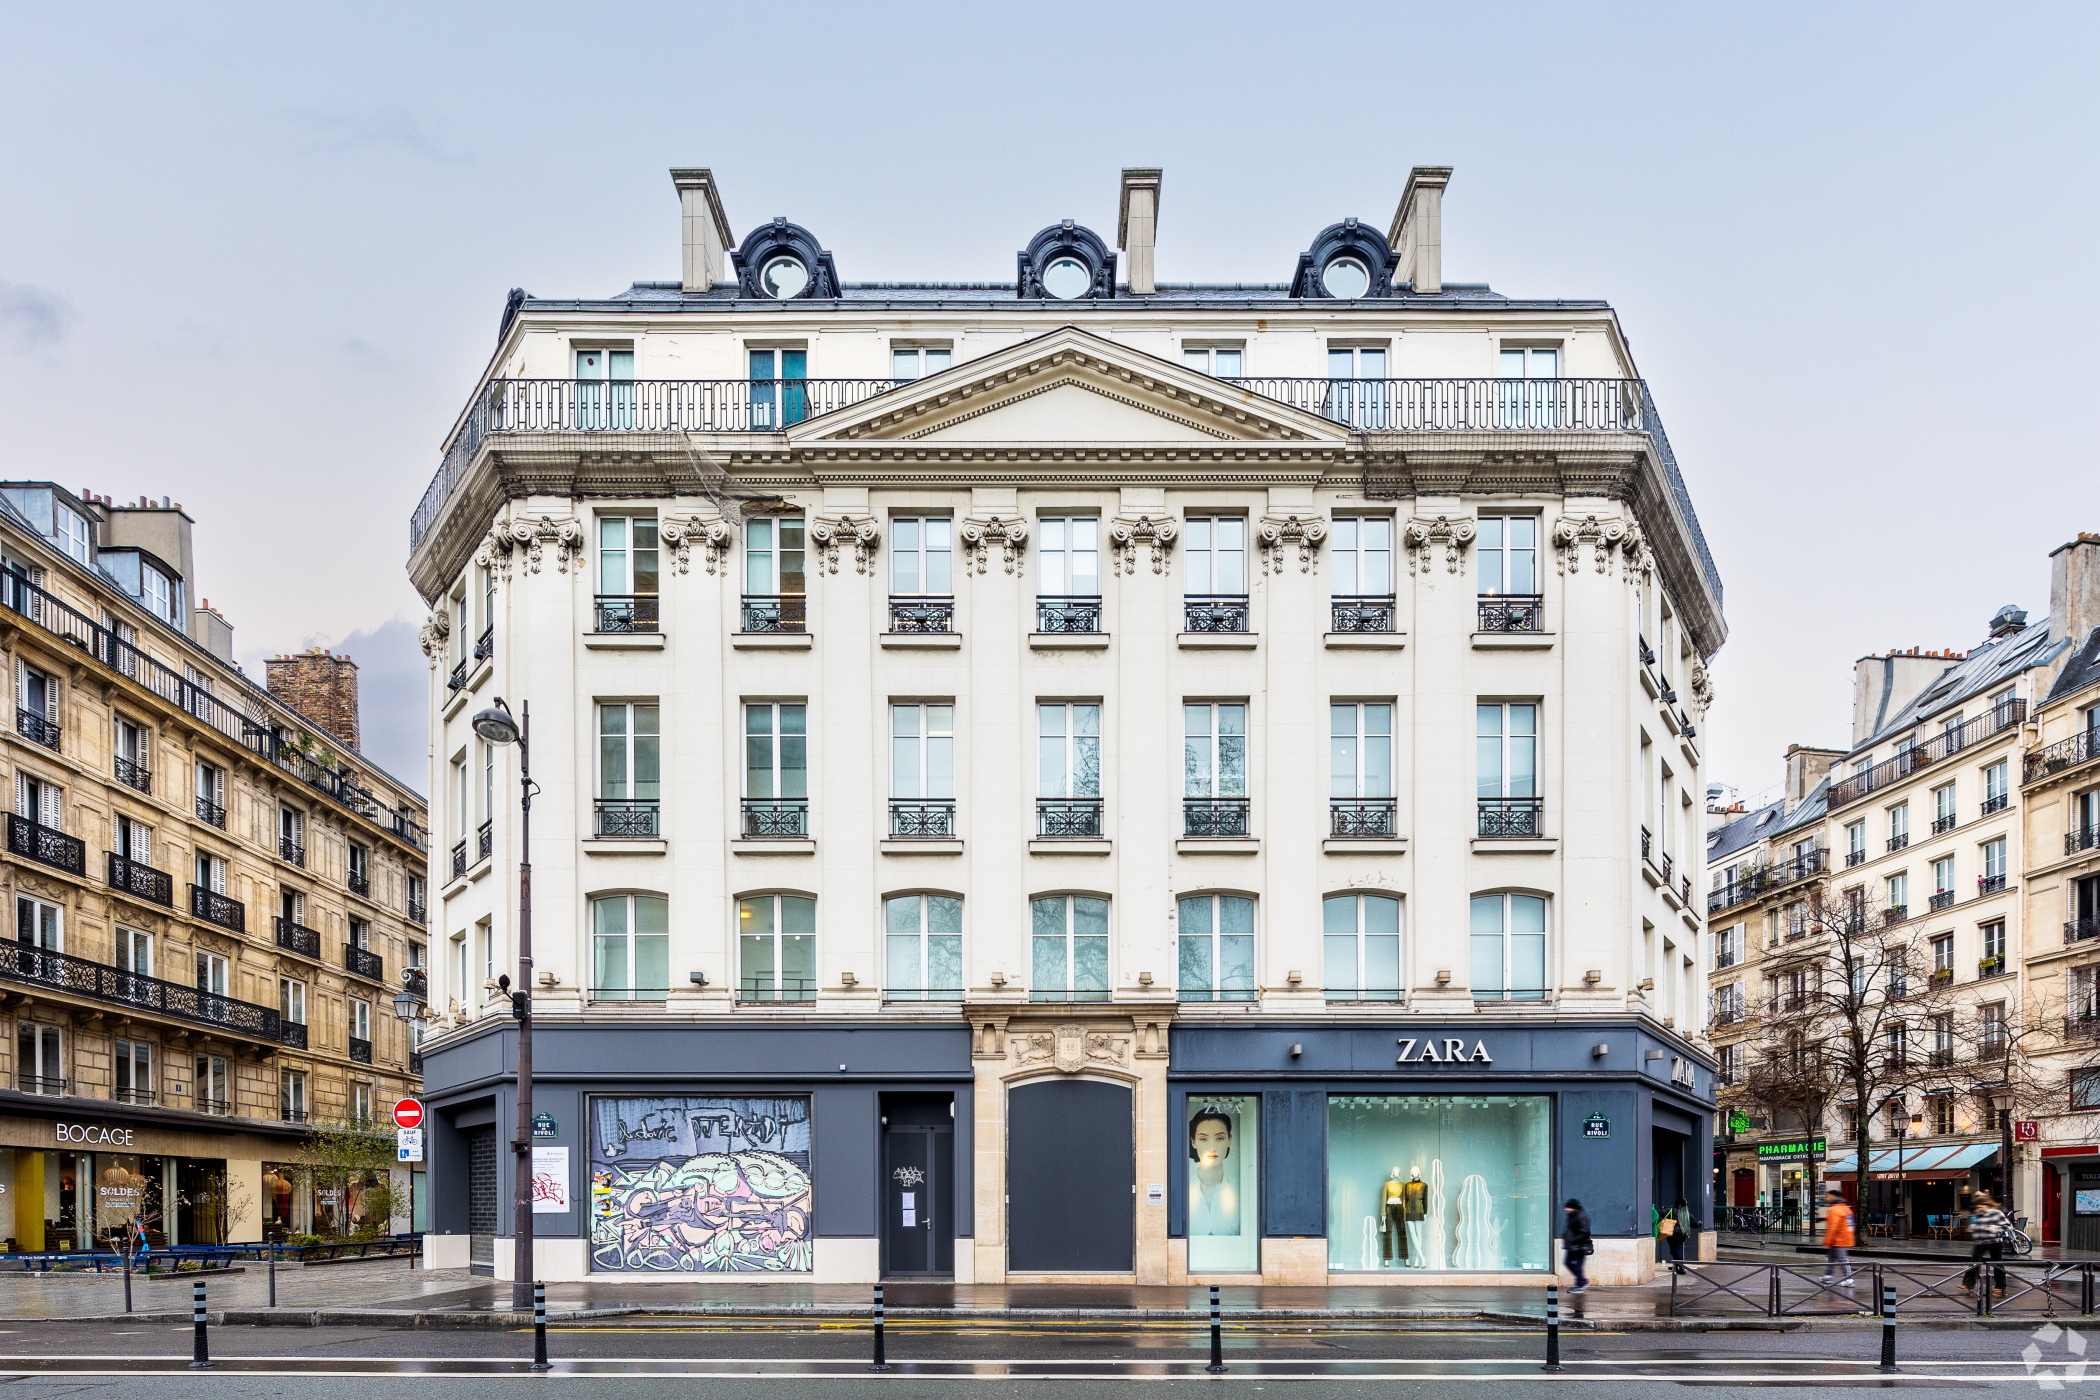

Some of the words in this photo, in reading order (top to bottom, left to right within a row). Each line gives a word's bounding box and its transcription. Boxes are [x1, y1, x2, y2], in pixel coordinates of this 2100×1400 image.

[1066, 1042, 1075, 1051] 88
[1397, 1038, 1493, 1062] ZARA
[1671, 1055, 1696, 1089] ZARA
[56, 1123, 134, 1146] BOCAGE
[100, 1186, 140, 1197] SOLDES
